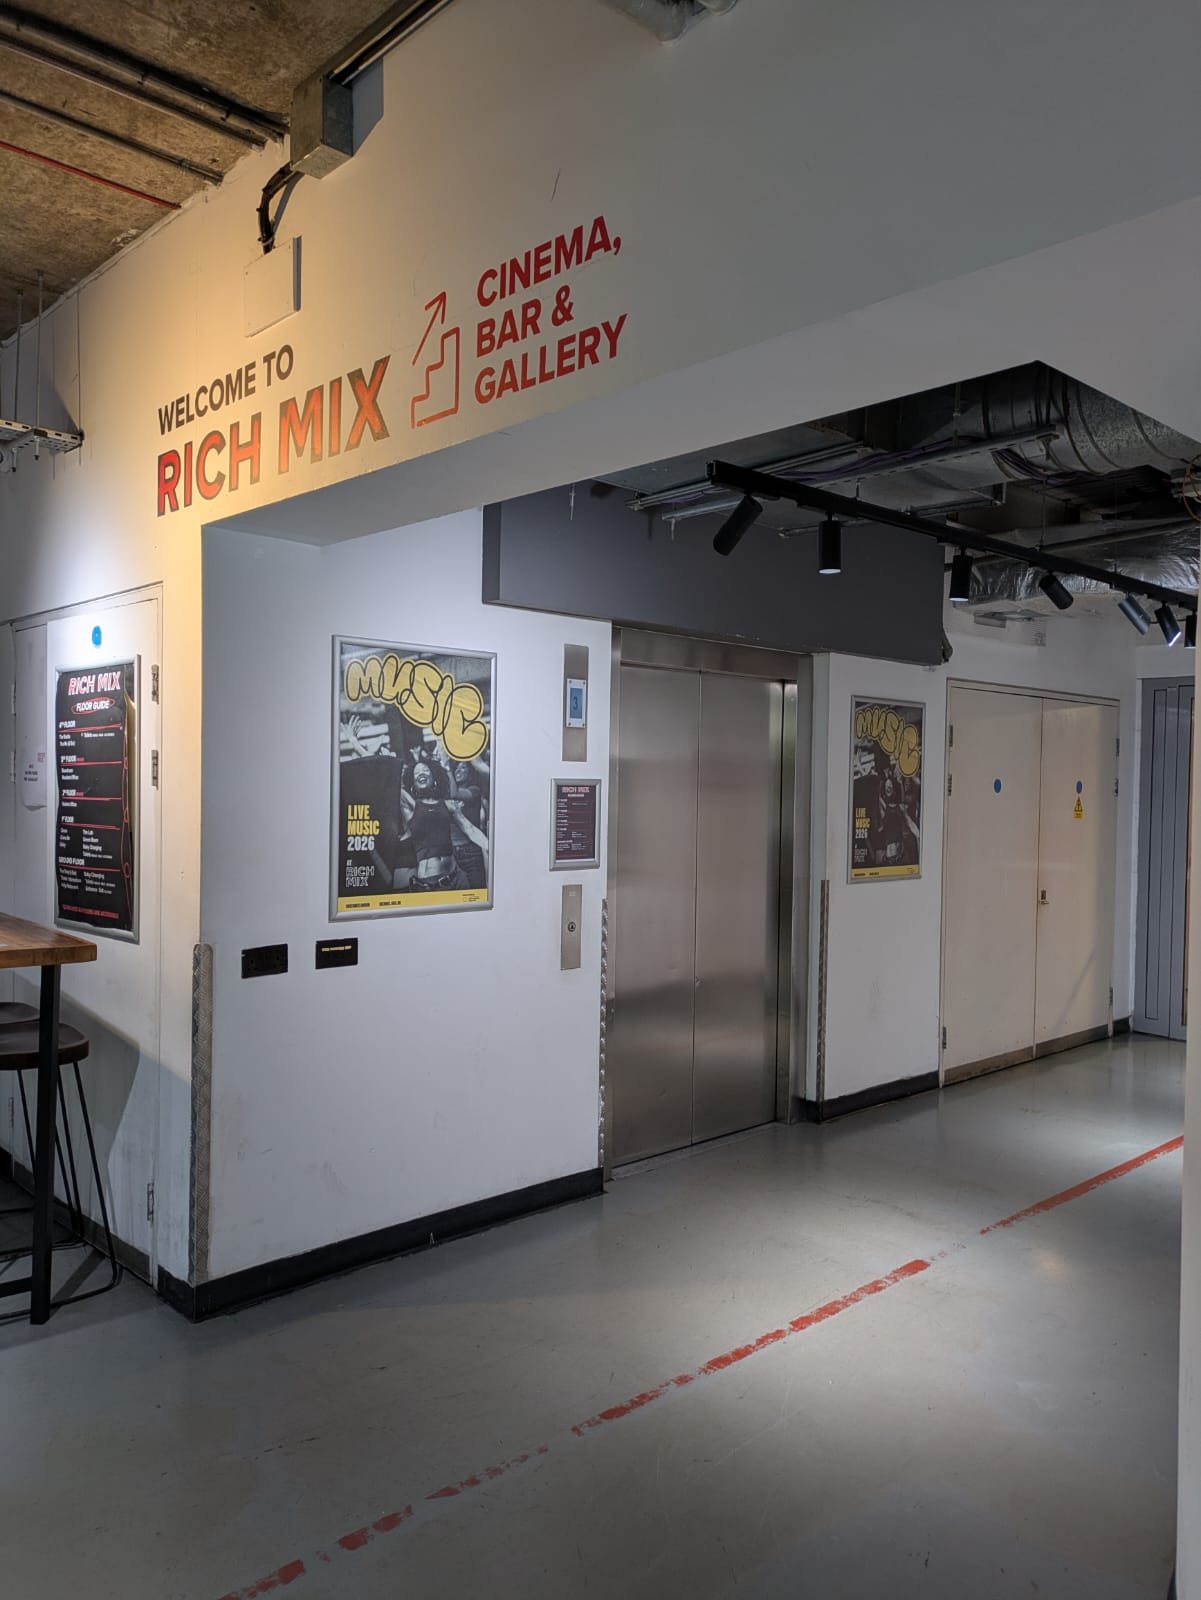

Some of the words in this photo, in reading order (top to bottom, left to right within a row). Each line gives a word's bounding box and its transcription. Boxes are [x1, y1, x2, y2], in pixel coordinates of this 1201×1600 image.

[477, 215, 622, 307] CINEMA,
[476, 298, 542, 358] BAR
[551, 284, 575, 327] &
[474, 313, 628, 405] GALLERY
[158, 371, 256, 435] WELCOME
[262, 344, 294, 387] TO
[157, 411, 262, 517] RICH
[278, 355, 391, 475] MIX
[68, 675, 96, 695] RICH
[98, 671, 121, 692] MIX
[76, 702, 92, 712] FLOOR
[92, 700, 110, 711] GUIDE
[345, 652, 489, 762] MUSIC
[573, 695, 579, 711] 3
[855, 706, 919, 778] MUSIC
[347, 804, 370, 820] LIVE
[855, 808, 866, 818] LIVE
[347, 820, 380, 836] MUSIC
[855, 818, 871, 828] MUSIC
[347, 836, 375, 851] 2026
[345, 866, 375, 877] RICH
[345, 876, 369, 887] MIX
